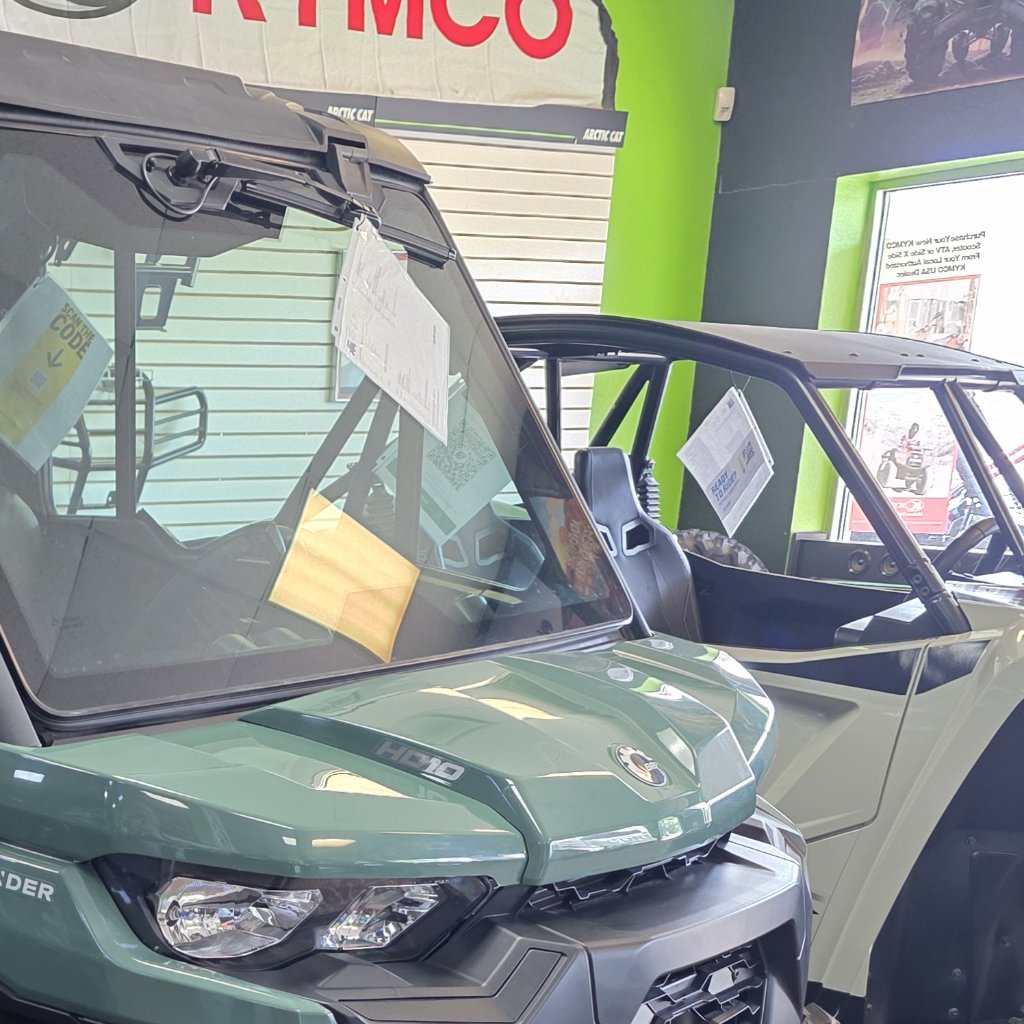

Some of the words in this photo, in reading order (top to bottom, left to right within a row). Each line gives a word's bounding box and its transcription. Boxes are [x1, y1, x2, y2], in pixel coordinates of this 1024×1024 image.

[192, 0, 573, 60] MCO
[356, 108, 375, 122] CAT
[582, 128, 610, 142] ARCTIC
[609, 130, 625, 143] CAT
[49, 313, 88, 360] CODE
[61, 302, 81, 328] SCAN
[80, 323, 96, 348] THE
[711, 470, 728, 495] READY
[376, 740, 465, 781] HD10
